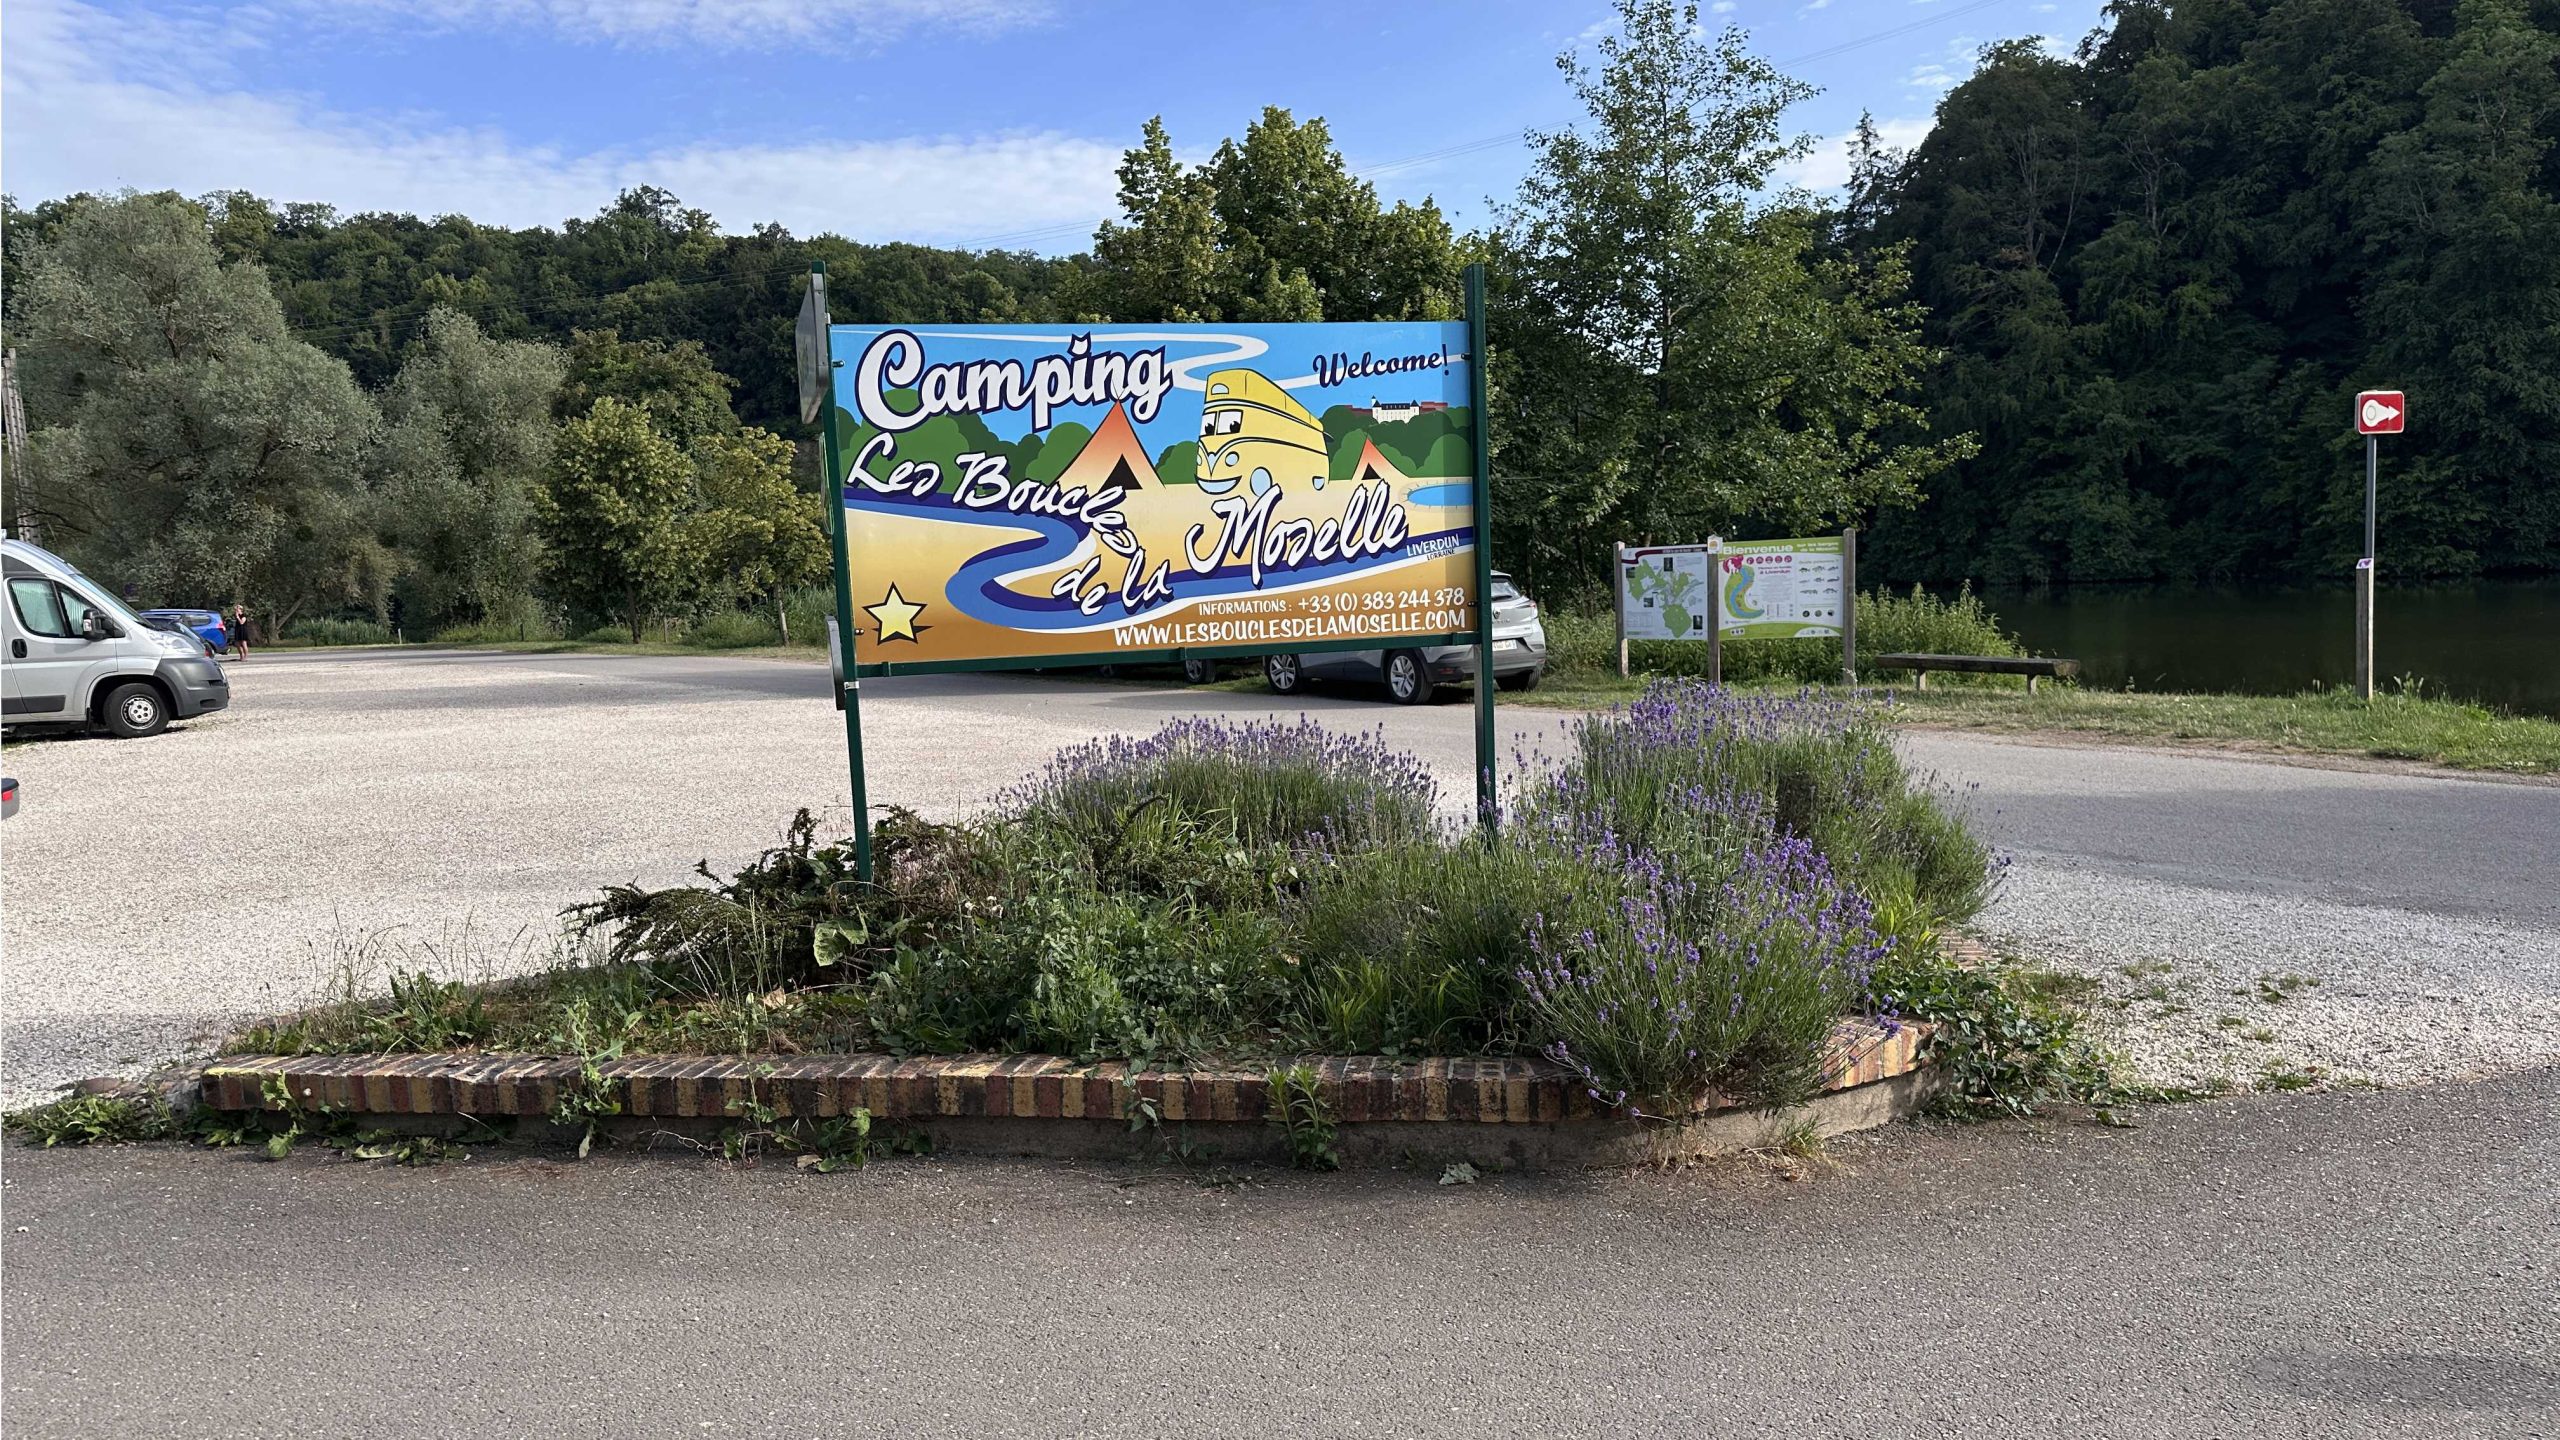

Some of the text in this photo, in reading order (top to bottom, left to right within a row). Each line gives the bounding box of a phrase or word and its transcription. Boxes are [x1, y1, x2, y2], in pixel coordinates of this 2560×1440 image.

[855, 329, 1174, 433] Camping
[1313, 344, 1449, 388] Welcome!
[845, 432, 1409, 616] Les Boucles de la Moselle
[1406, 533, 1460, 557] LIVERDUN
[1426, 549, 1455, 561] LORRAINE
[1722, 544, 1794, 555] Bienvenue
[1298, 595, 1331, 613] +33
[1335, 592, 1358, 612] (0)
[1361, 591, 1394, 610] 383
[1398, 589, 1431, 609] 244
[1434, 587, 1465, 606] 378
[1114, 608, 1466, 646] WWW.LESBOUCLESDELAMOSELLE.COM
